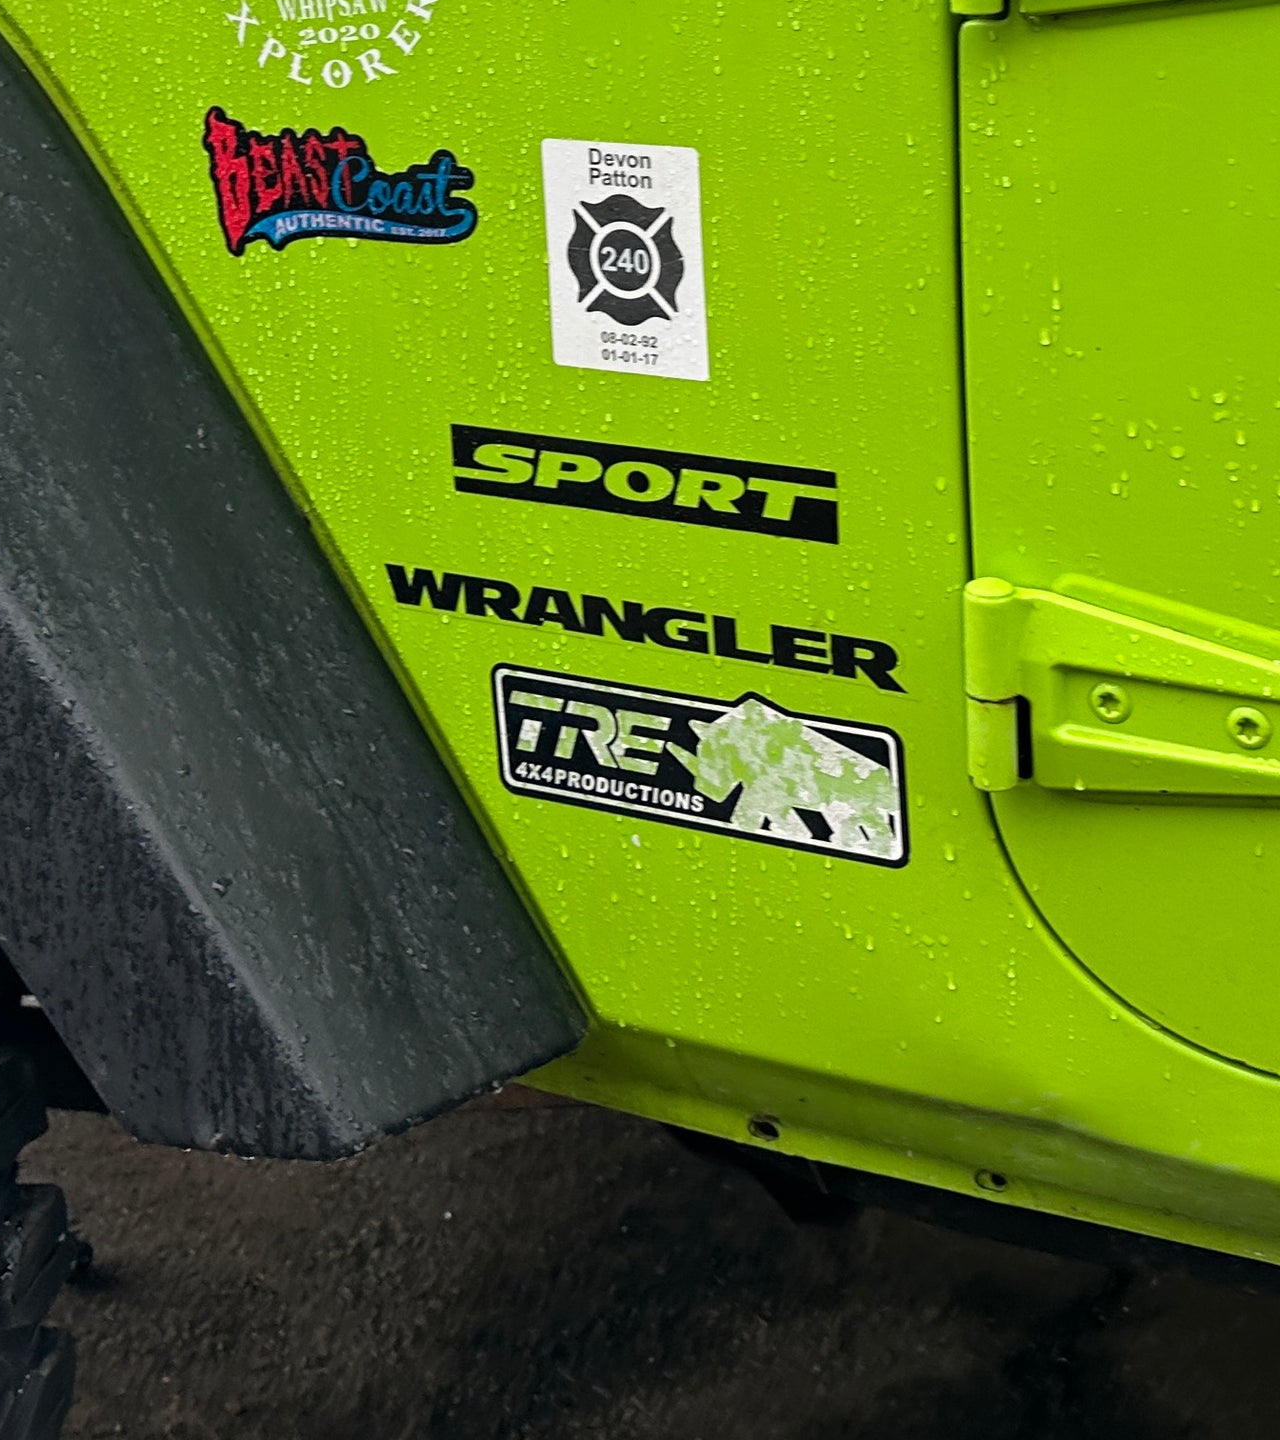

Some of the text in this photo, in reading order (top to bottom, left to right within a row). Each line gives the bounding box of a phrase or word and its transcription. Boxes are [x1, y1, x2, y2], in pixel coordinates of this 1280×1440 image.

[298, 23, 381, 46] 2020
[589, 148, 652, 169] Devon
[331, 155, 471, 215] Coast
[589, 167, 653, 189] Patton
[274, 213, 386, 237] AUTHENTIC
[600, 246, 650, 275] 240
[602, 349, 659, 365] 01-01-17
[455, 442, 838, 522] SPORT
[384, 563, 910, 694] WRANGLER
